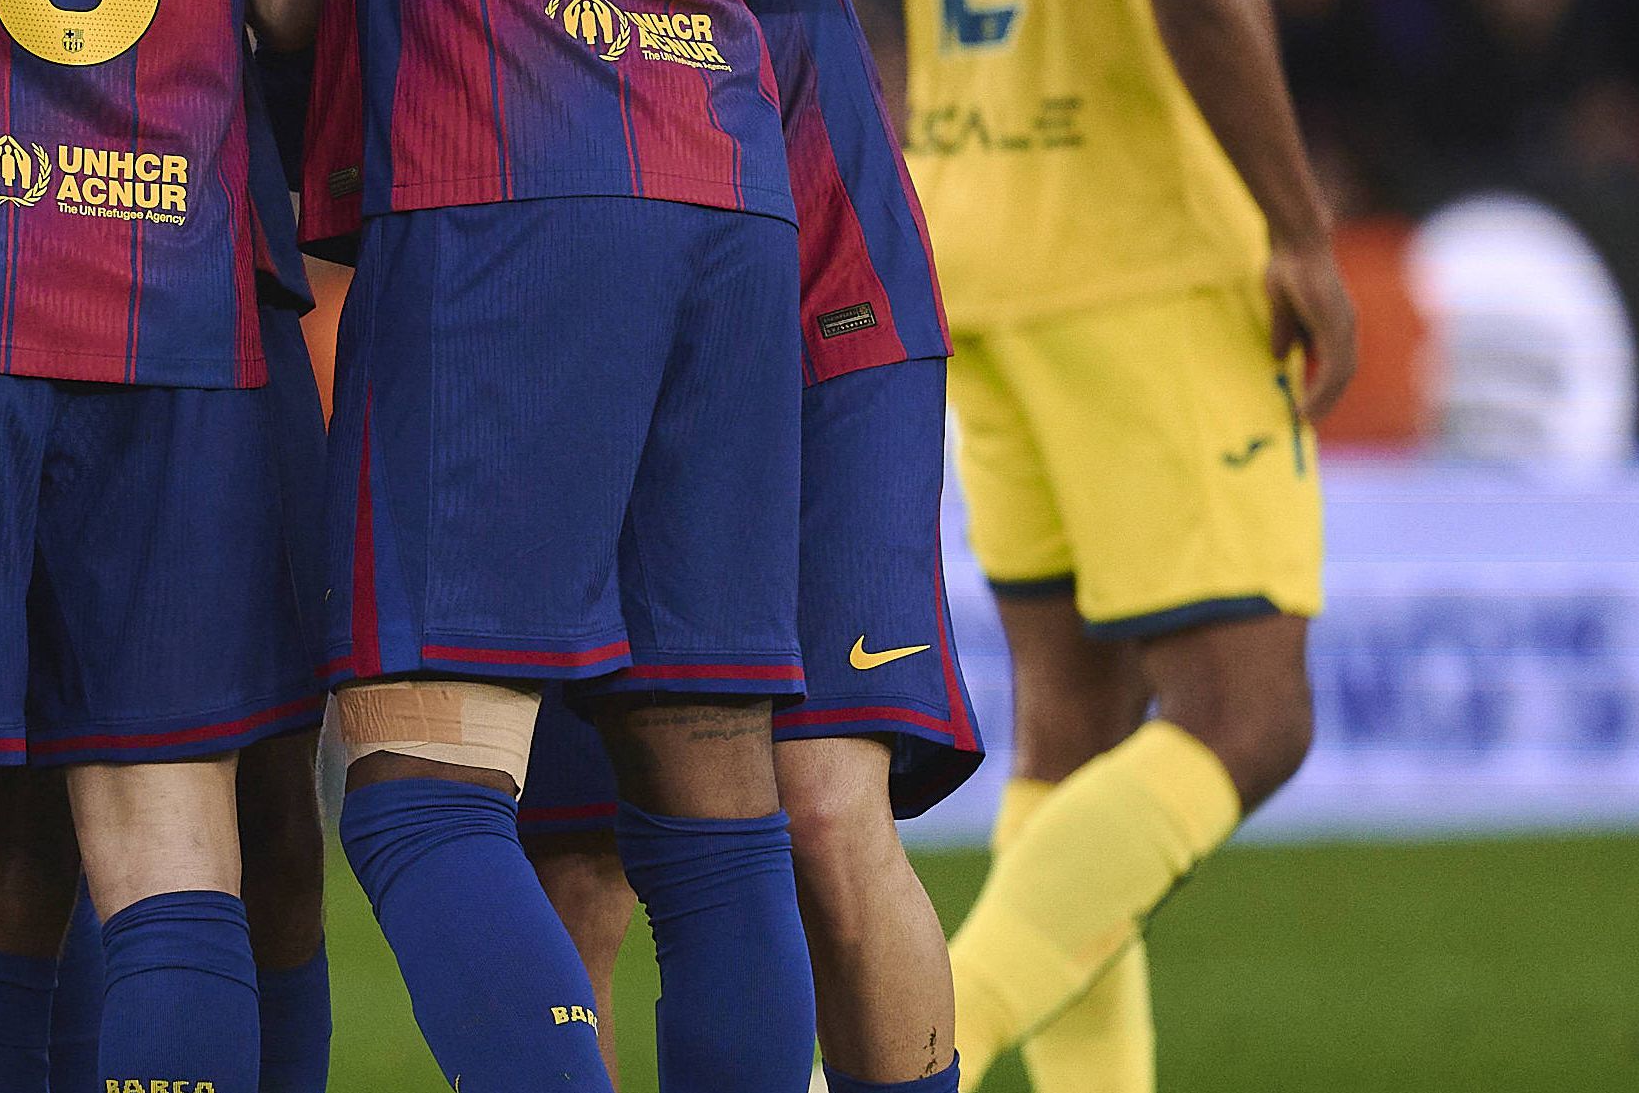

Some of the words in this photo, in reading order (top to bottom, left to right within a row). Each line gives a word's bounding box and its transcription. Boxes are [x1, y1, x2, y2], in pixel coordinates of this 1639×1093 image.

[58, 145, 188, 184] UNHCR
[56, 174, 187, 212] ACNUR
[58, 201, 78, 215] The
[79, 205, 97, 217] UN
[97, 207, 144, 221] Refugee
[144, 209, 186, 226] Agency
[550, 1005, 599, 1037] BAR
